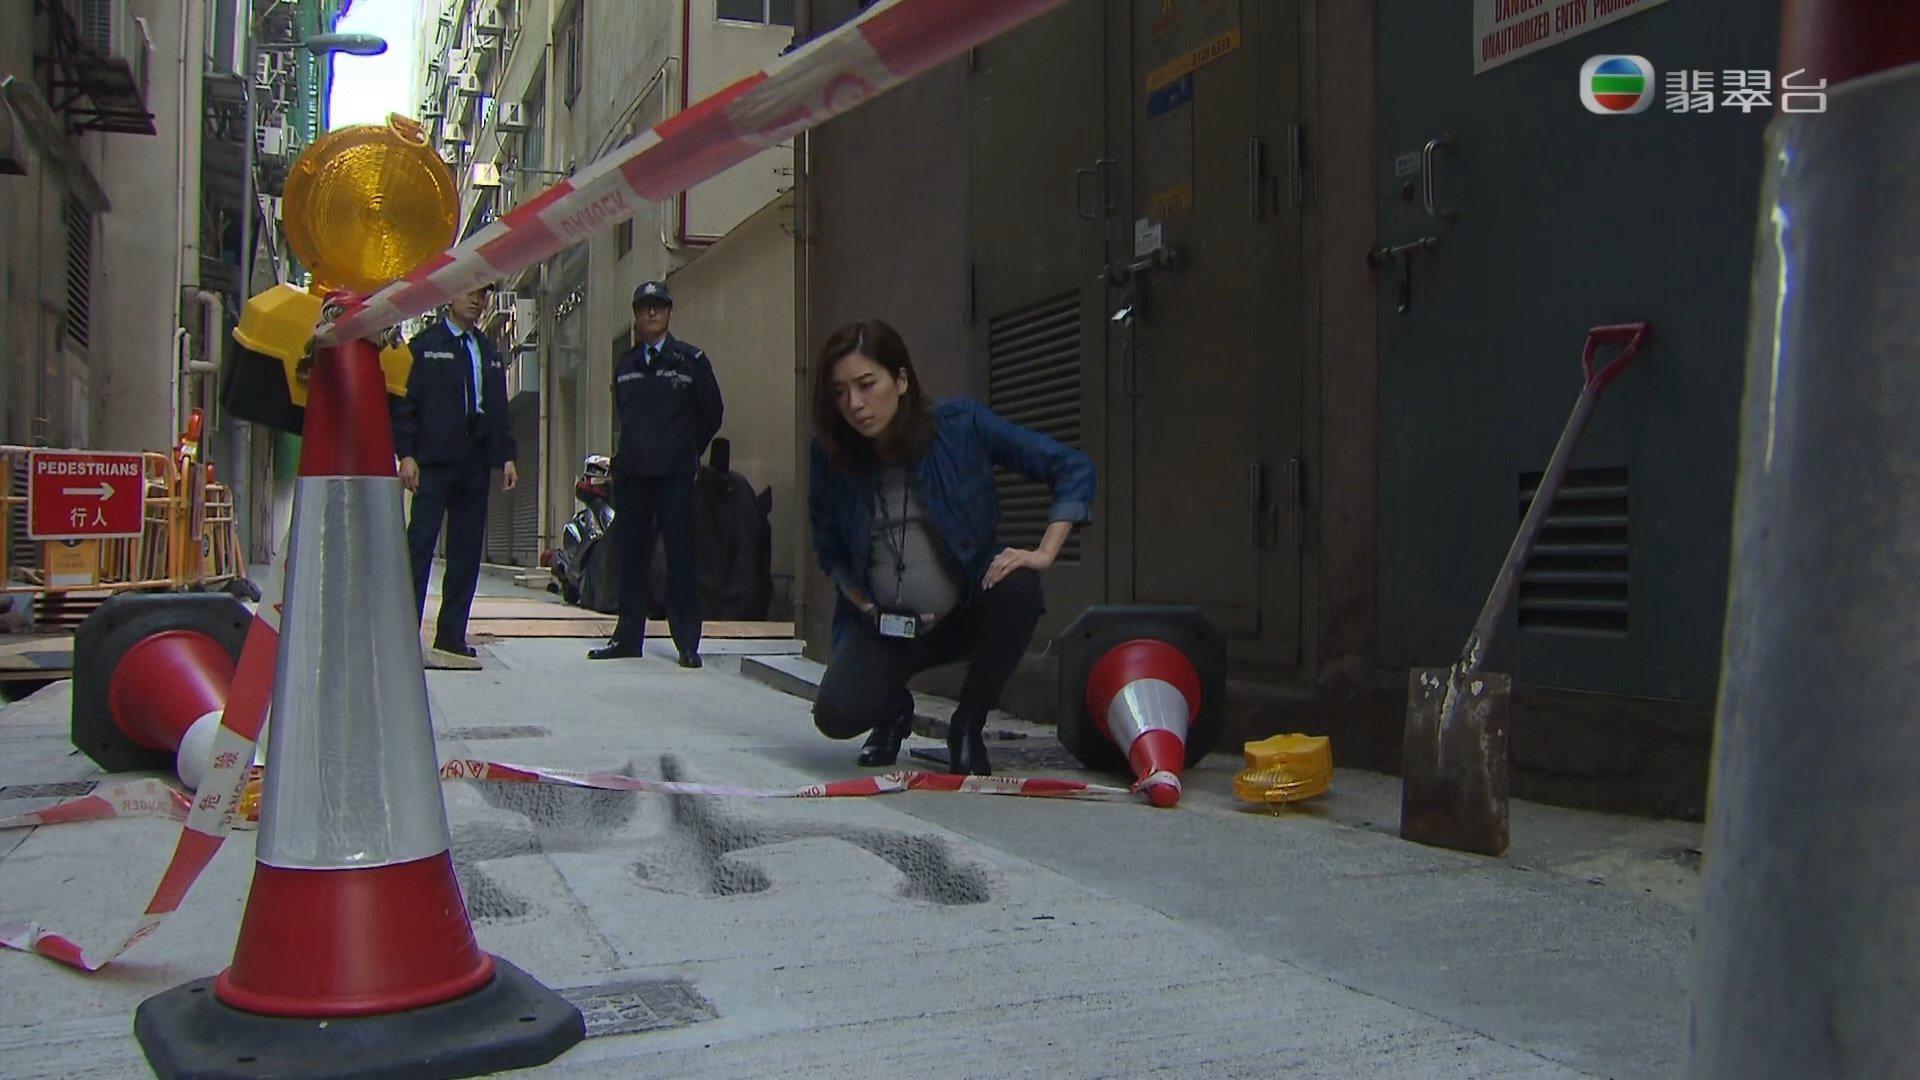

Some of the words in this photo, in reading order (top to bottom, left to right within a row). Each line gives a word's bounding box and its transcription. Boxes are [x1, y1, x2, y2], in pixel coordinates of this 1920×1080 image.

[1482, 11, 1550, 62] UNAUTHORIZED
[1554, 0, 1588, 32] ENTRY
[37, 461, 139, 476] PEDESTRIANS
[70, 507, 107, 527] 行人
